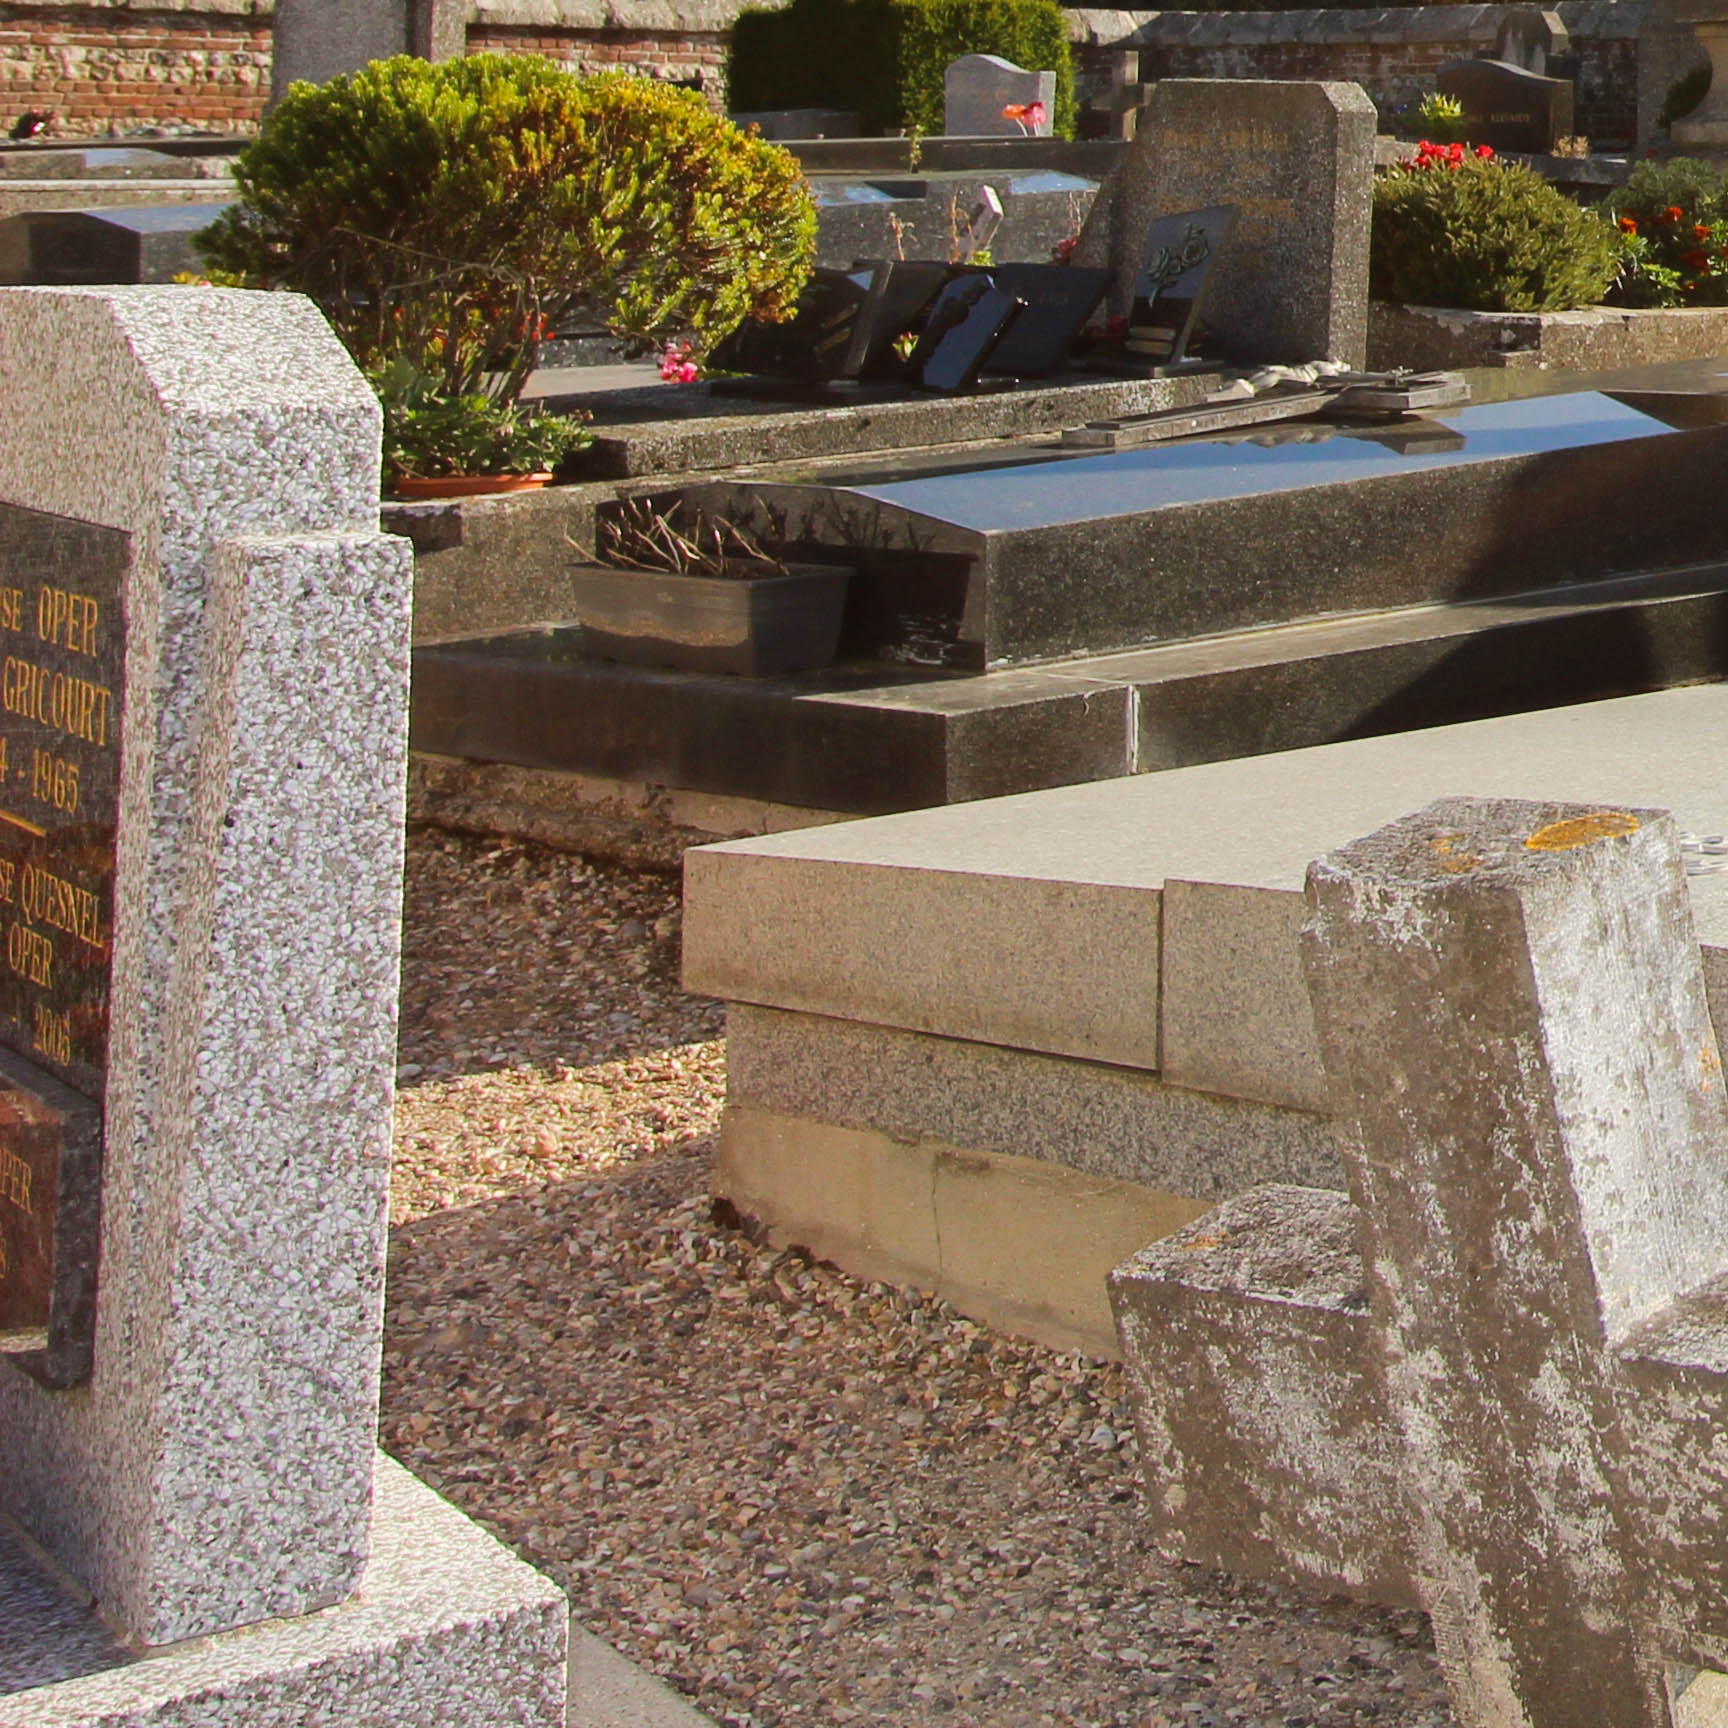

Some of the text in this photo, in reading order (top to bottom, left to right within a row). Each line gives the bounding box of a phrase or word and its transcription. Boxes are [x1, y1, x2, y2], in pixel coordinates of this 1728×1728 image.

[37, 585, 99, 658] OPER
[3, 655, 112, 747] GRICOURT
[32, 747, 80, 815] 1965
[21, 862, 104, 949] QUESNEL
[9, 920, 53, 990] OPER
[0, 1147, 33, 1216] PER
